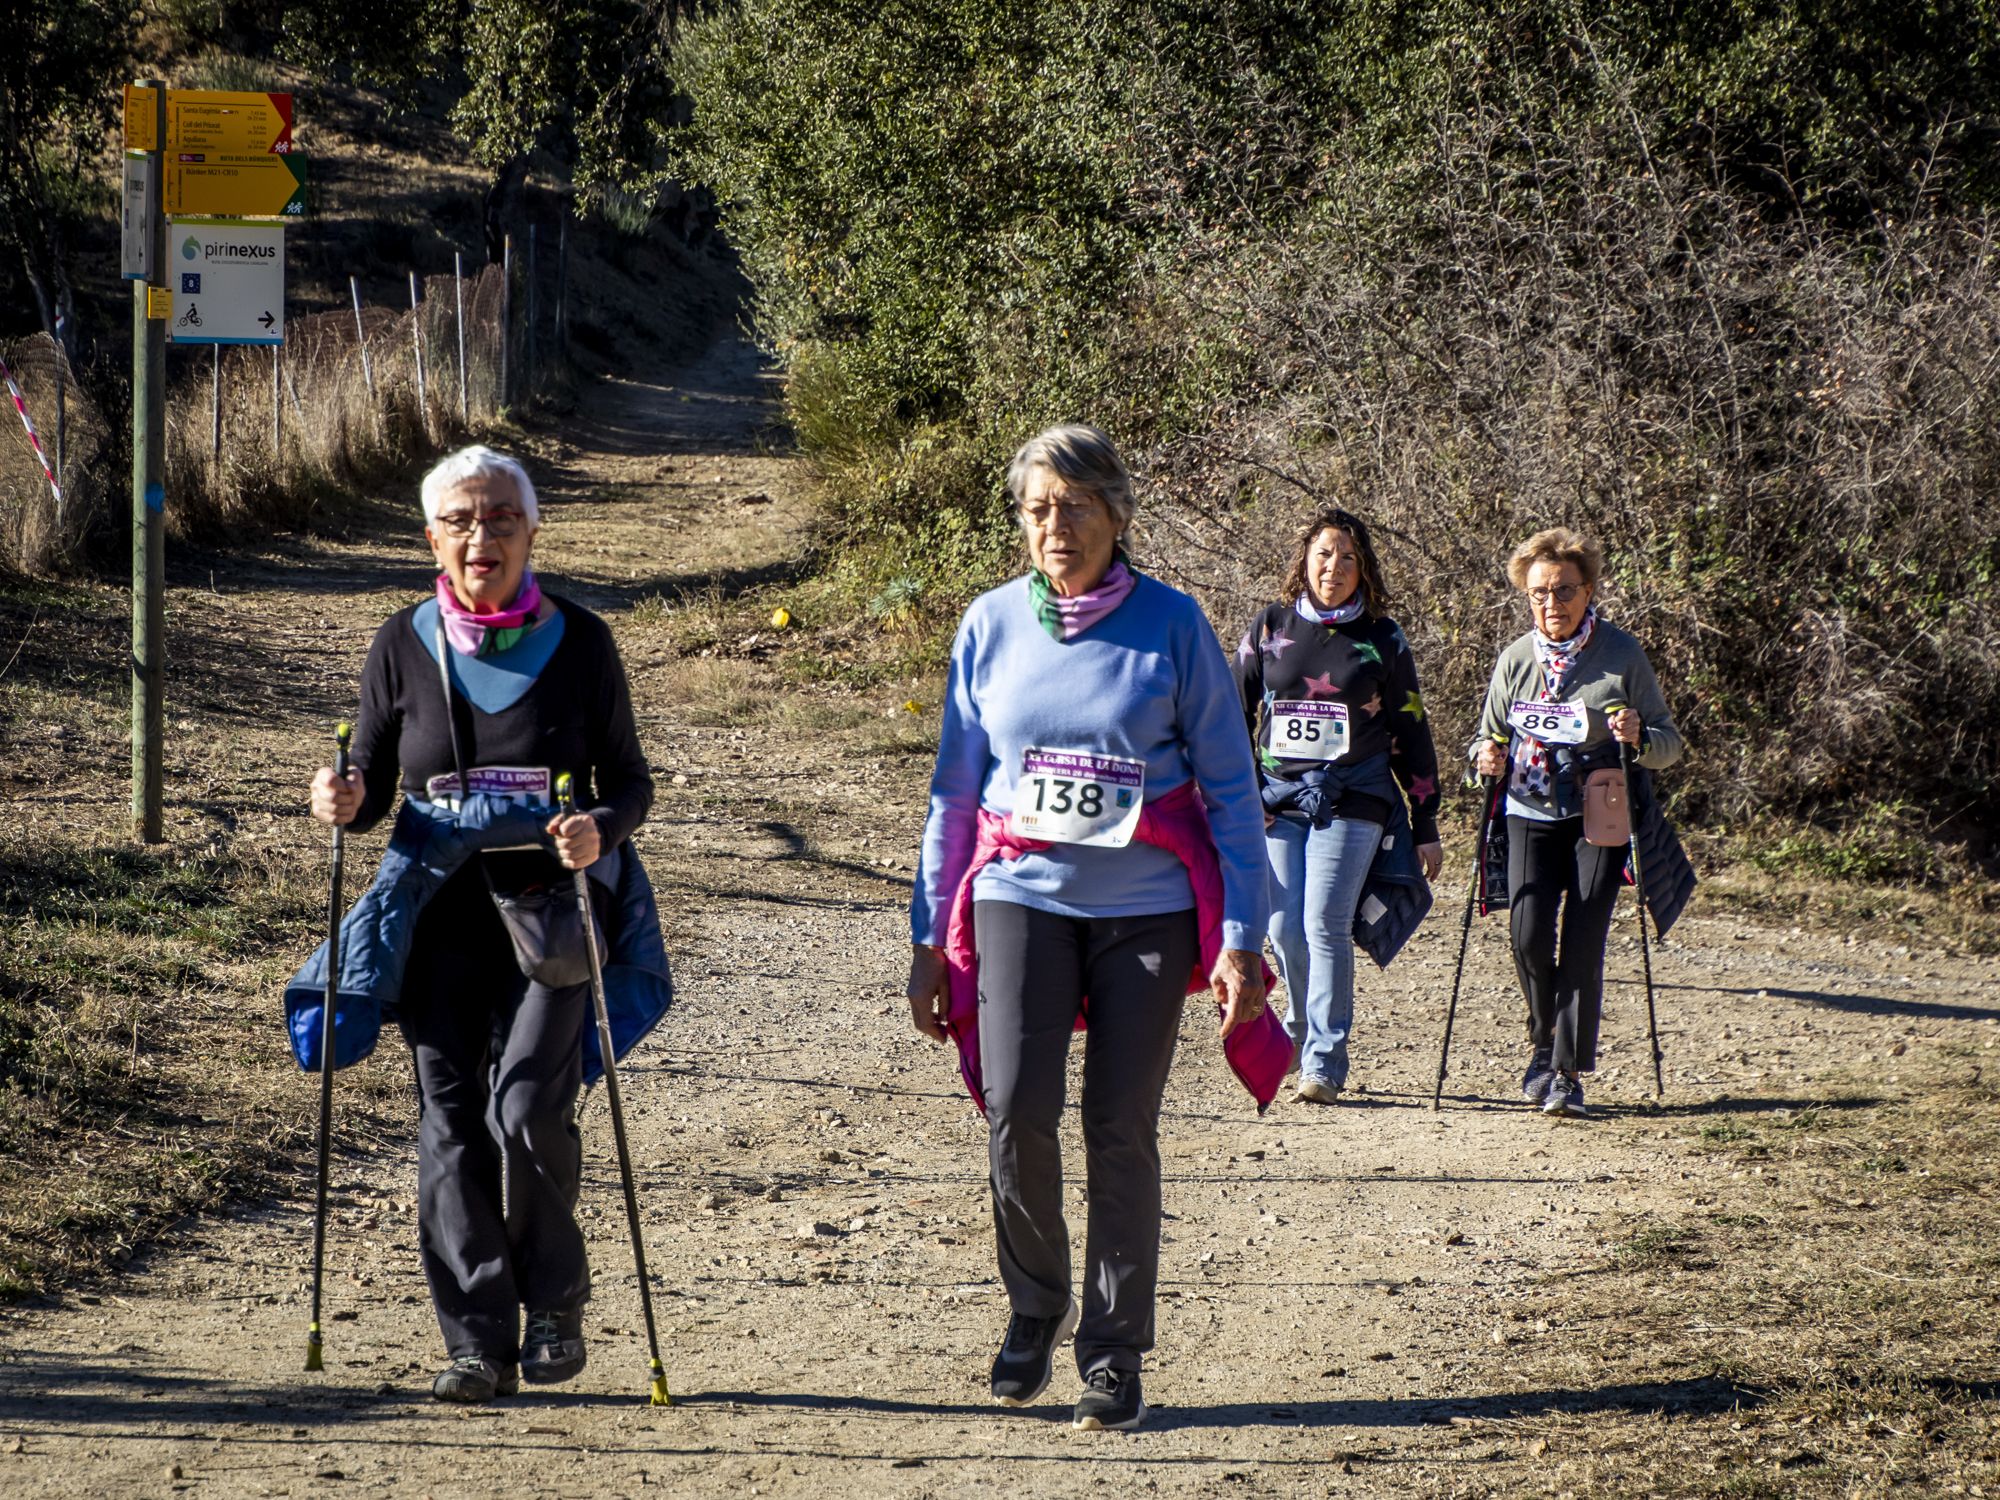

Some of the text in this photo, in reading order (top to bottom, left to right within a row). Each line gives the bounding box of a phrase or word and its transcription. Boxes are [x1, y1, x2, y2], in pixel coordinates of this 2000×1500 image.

[205, 242, 276, 260] pirinexus
[188, 280, 194, 288] 8
[1286, 718, 1320, 742] 85
[1522, 714, 1560, 730] 86
[1043, 754, 1076, 766] CURSA
[1079, 757, 1094, 768] DE
[1096, 760, 1110, 770] LA
[1112, 762, 1140, 775] DONA
[500, 773, 513, 782] LA
[1033, 778, 1104, 818] 138
